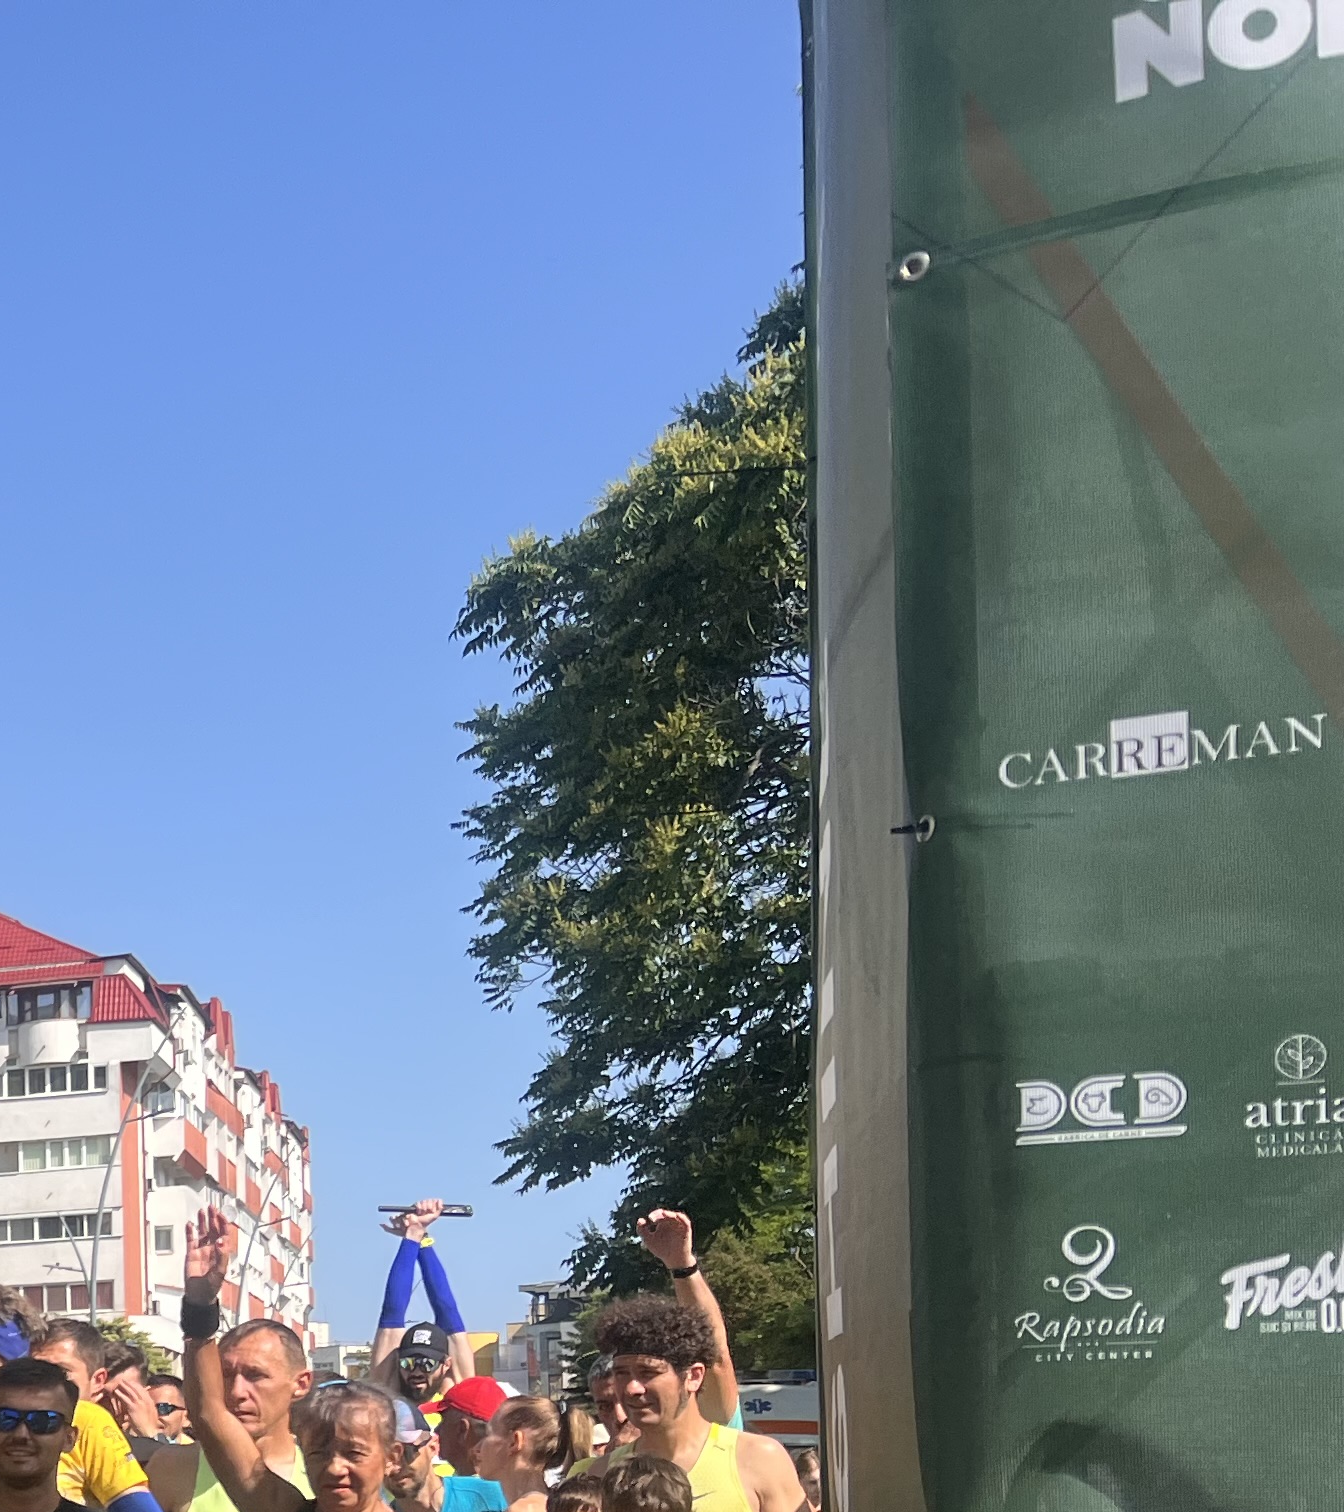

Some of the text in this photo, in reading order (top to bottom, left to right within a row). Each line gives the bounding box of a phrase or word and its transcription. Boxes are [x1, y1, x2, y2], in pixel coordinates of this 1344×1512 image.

[999, 712, 1328, 789] CARREMAN
[1014, 1301, 1166, 1352] Rapsodia
[1035, 1350, 1153, 1363] CITY CENTER
